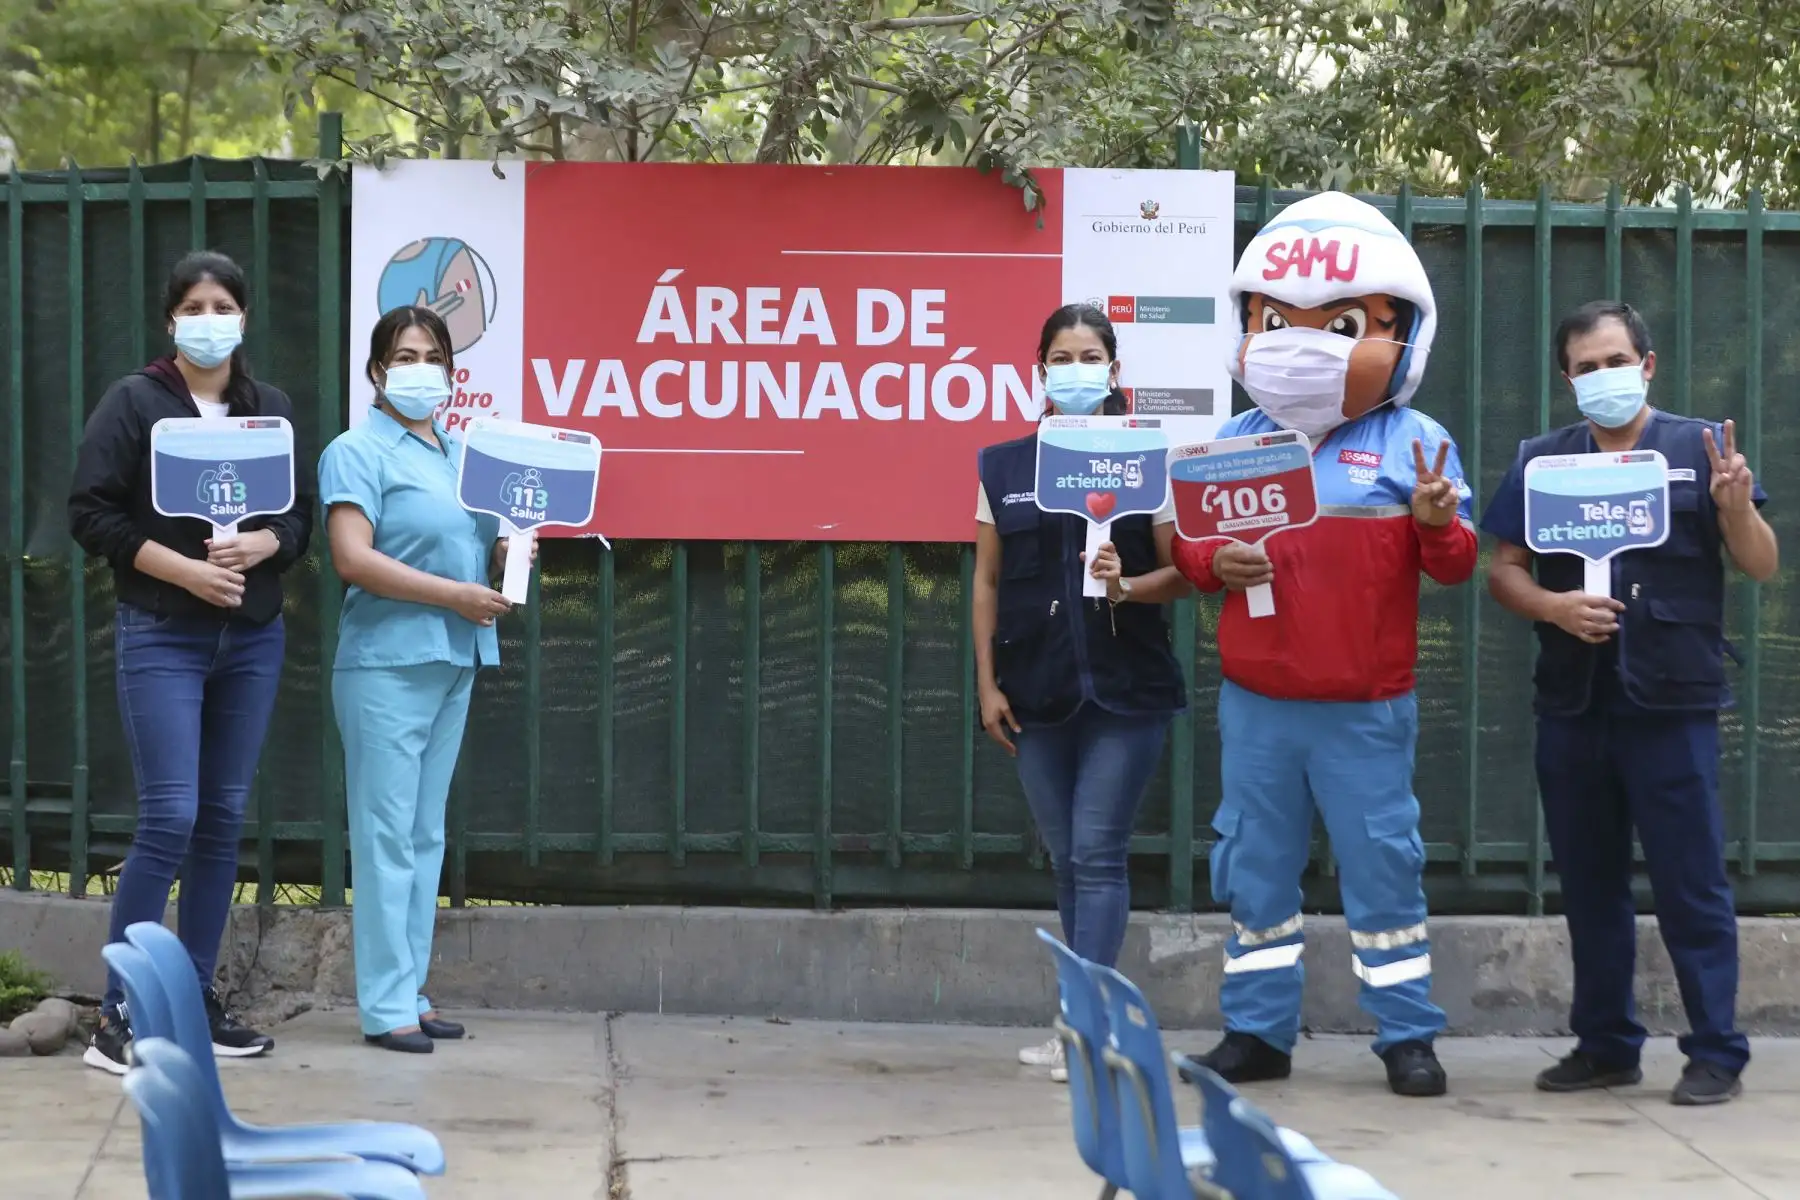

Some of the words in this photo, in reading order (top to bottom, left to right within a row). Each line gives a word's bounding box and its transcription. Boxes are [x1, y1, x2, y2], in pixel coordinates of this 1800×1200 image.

[1091, 221, 1151, 233] Gobierno
[1154, 221, 1174, 233] del
[1178, 222, 1207, 234] Perú
[1262, 237, 1360, 282] SAMU
[636, 268, 837, 346] ÁREA
[856, 289, 946, 347] DE
[1111, 304, 1132, 313] PERÚ
[1139, 305, 1171, 313] Ministerio
[531, 347, 1046, 422] VACUNACIÓN
[1137, 390, 1171, 398] Ministerio
[1147, 397, 1184, 406] Transportes
[1185, 446, 1209, 456] SAMU
[1089, 459, 1122, 474] Tele
[1056, 473, 1122, 488] atiendo
[209, 482, 247, 502] 113
[512, 487, 548, 509] 113
[1212, 483, 1287, 519] 106
[210, 503, 247, 515] Salud
[510, 506, 546, 521] Salud
[1579, 501, 1625, 521] Tele
[1537, 520, 1626, 542] atiendo
